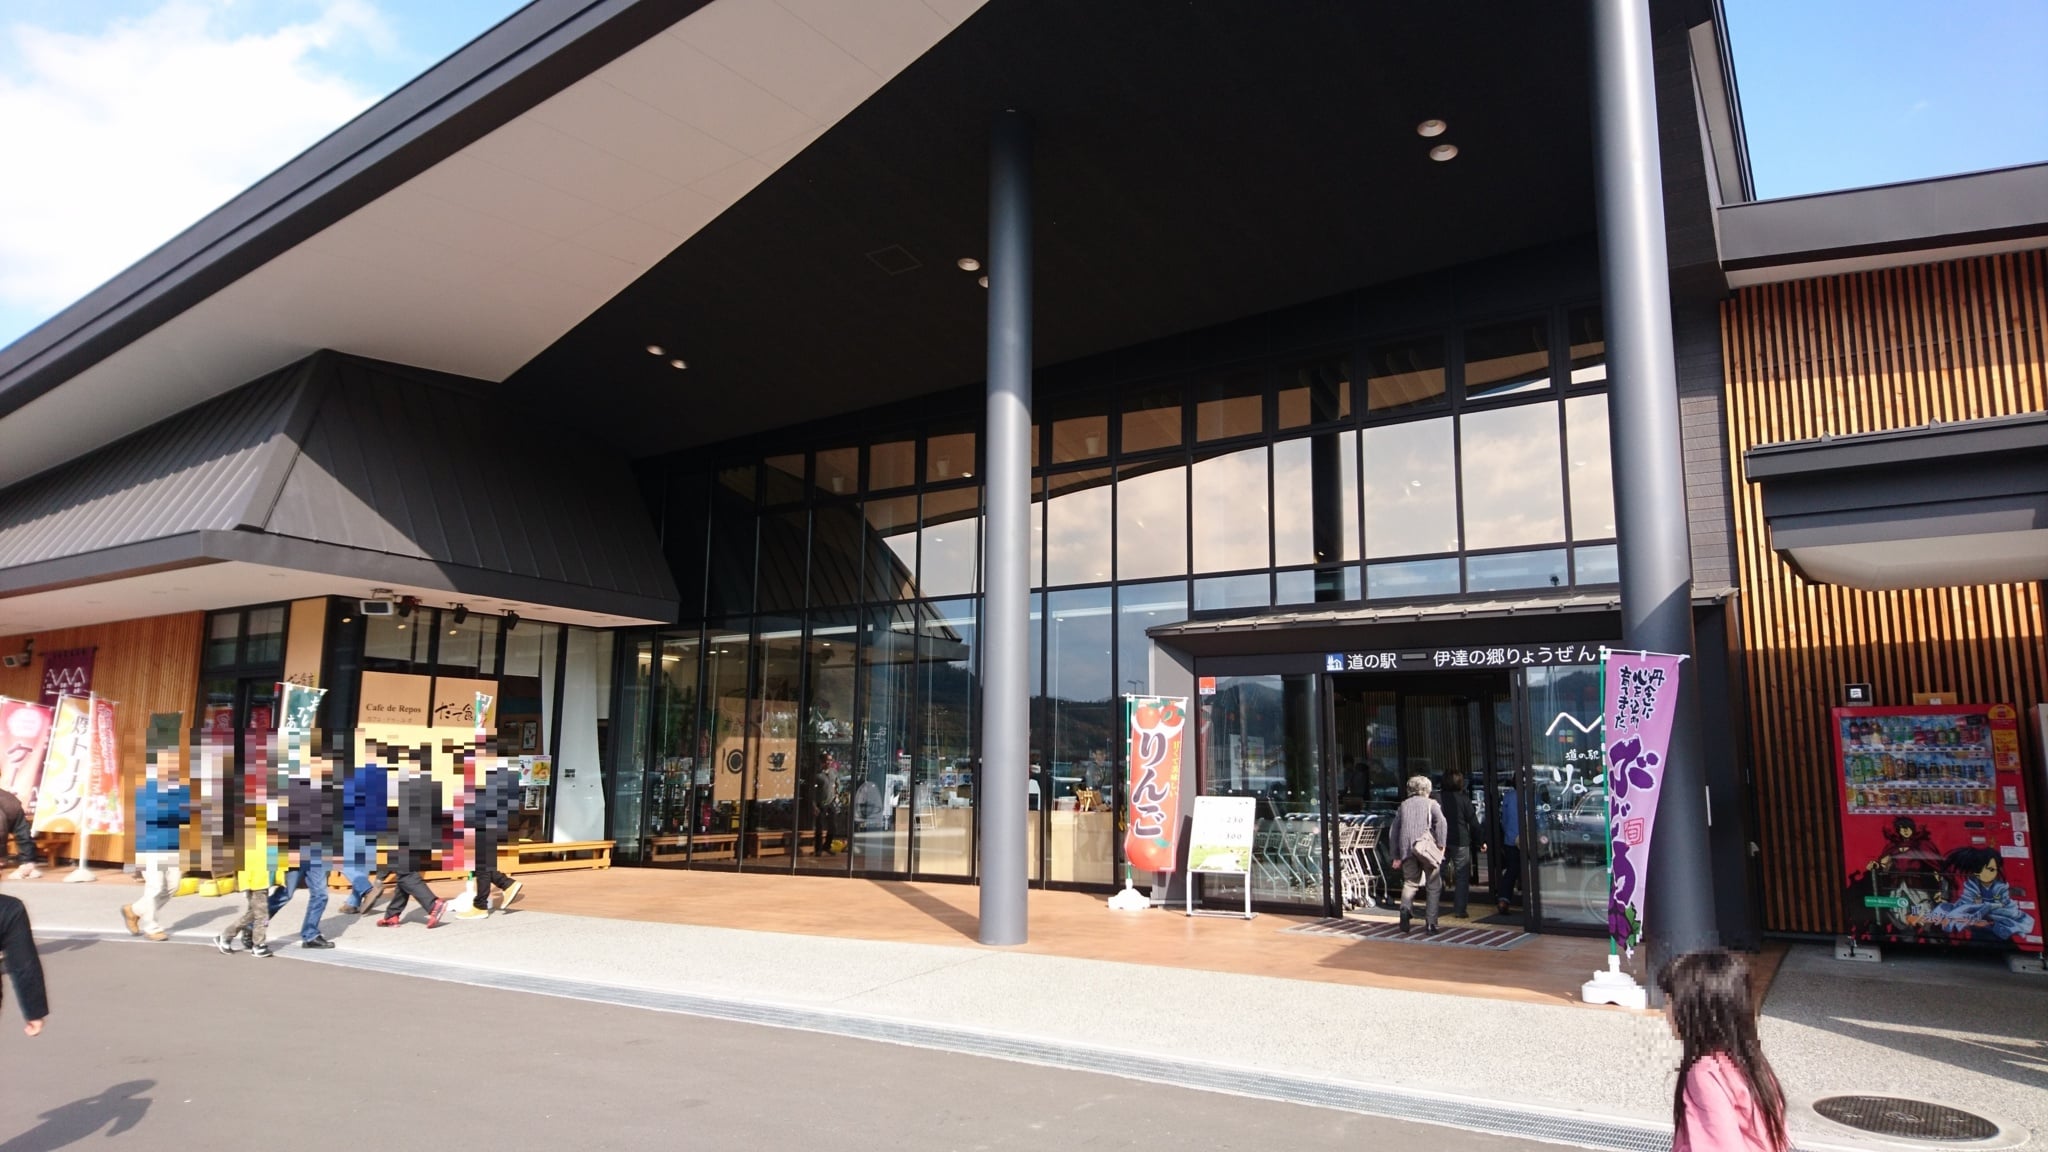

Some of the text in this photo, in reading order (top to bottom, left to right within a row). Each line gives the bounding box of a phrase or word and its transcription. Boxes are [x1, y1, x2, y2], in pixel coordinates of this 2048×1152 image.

[1347, 645, 1596, 671] 道の駅 伊達の郷りょうぜん
[366, 702, 422, 715] Cafe de Repos
[434, 701, 475, 722] だて食
[1565, 748, 1600, 761] 道の駅
[1132, 731, 1168, 838] りんご
